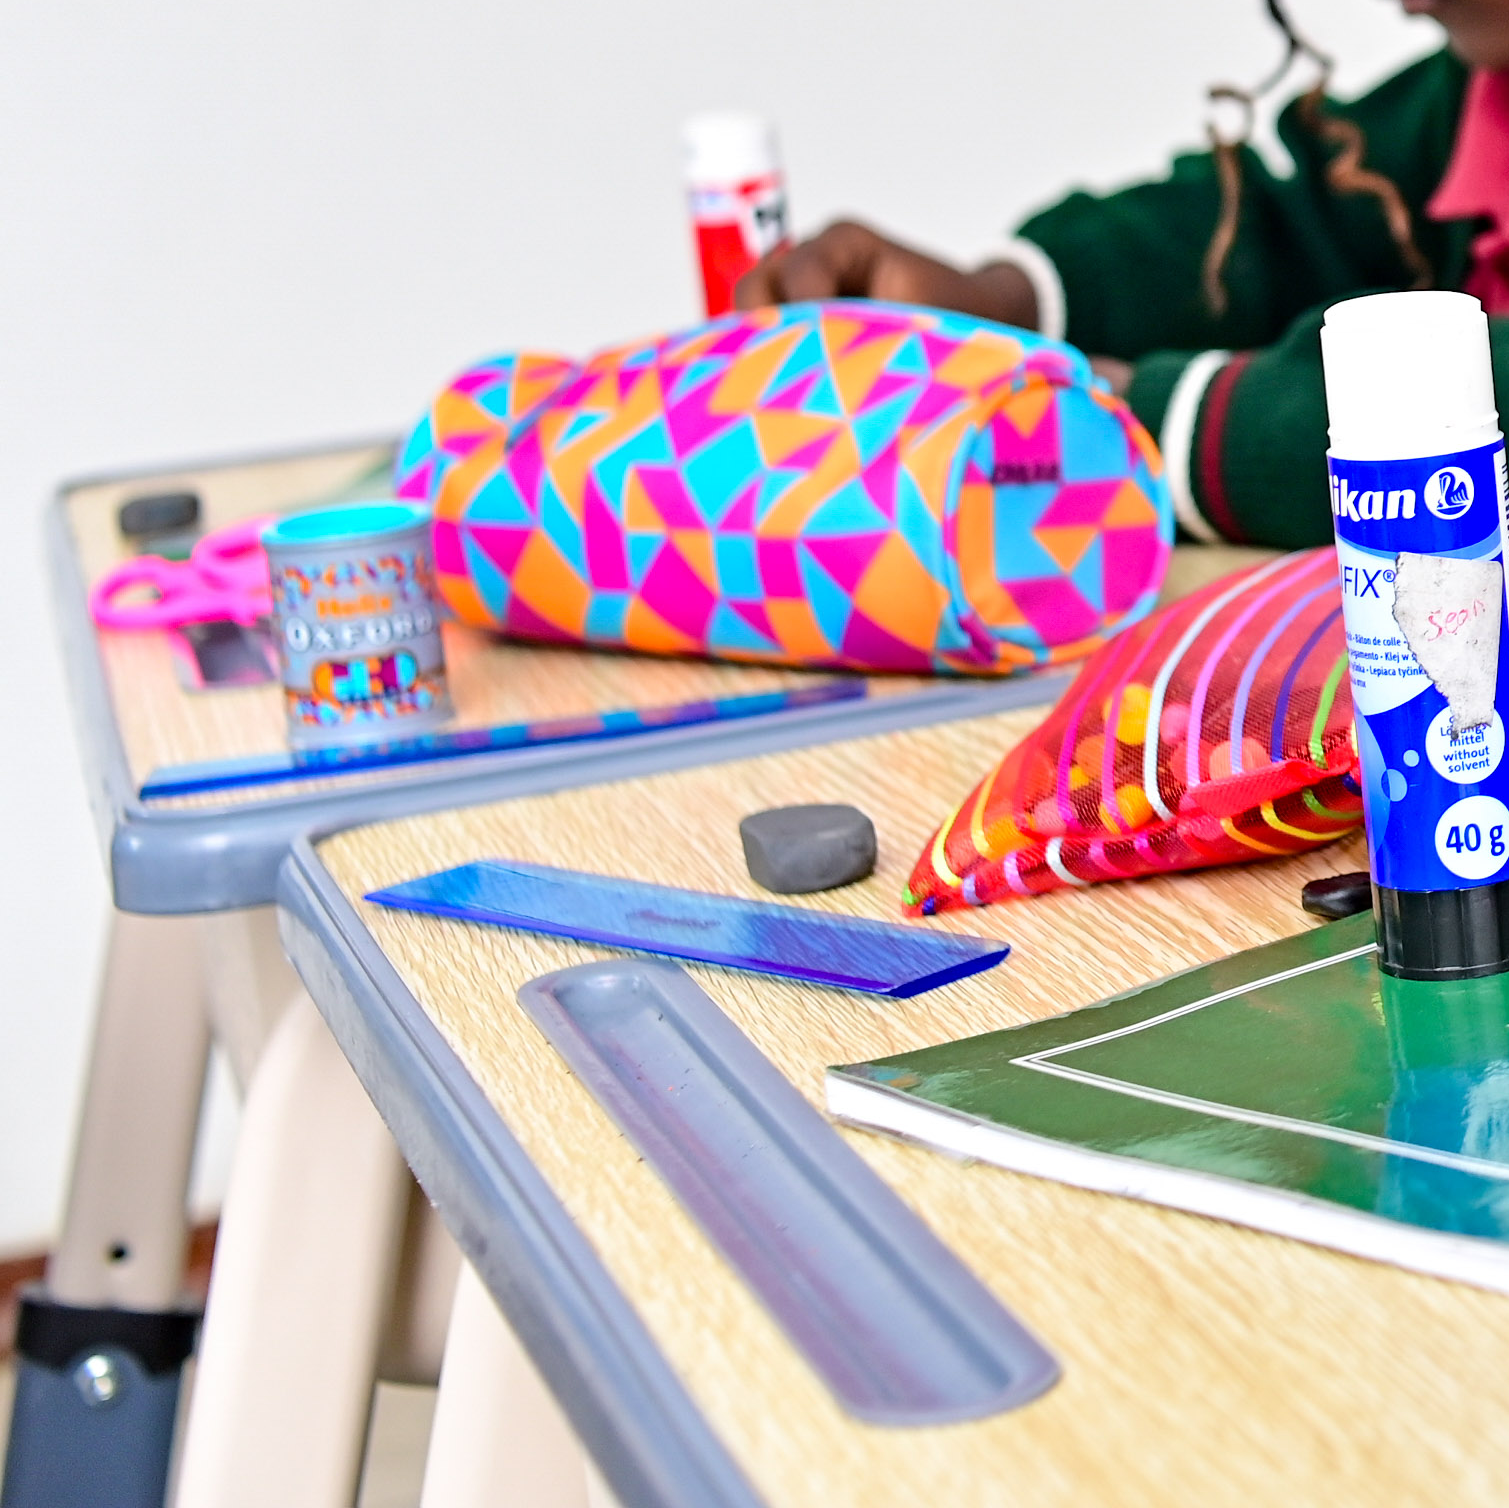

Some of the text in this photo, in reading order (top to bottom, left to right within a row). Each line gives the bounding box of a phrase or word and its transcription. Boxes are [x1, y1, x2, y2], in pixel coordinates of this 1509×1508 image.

[1383, 636, 1402, 646] colle
[1443, 745, 1490, 762] without
[1448, 756, 1490, 773] solvent
[1446, 823, 1506, 856] 40 g
